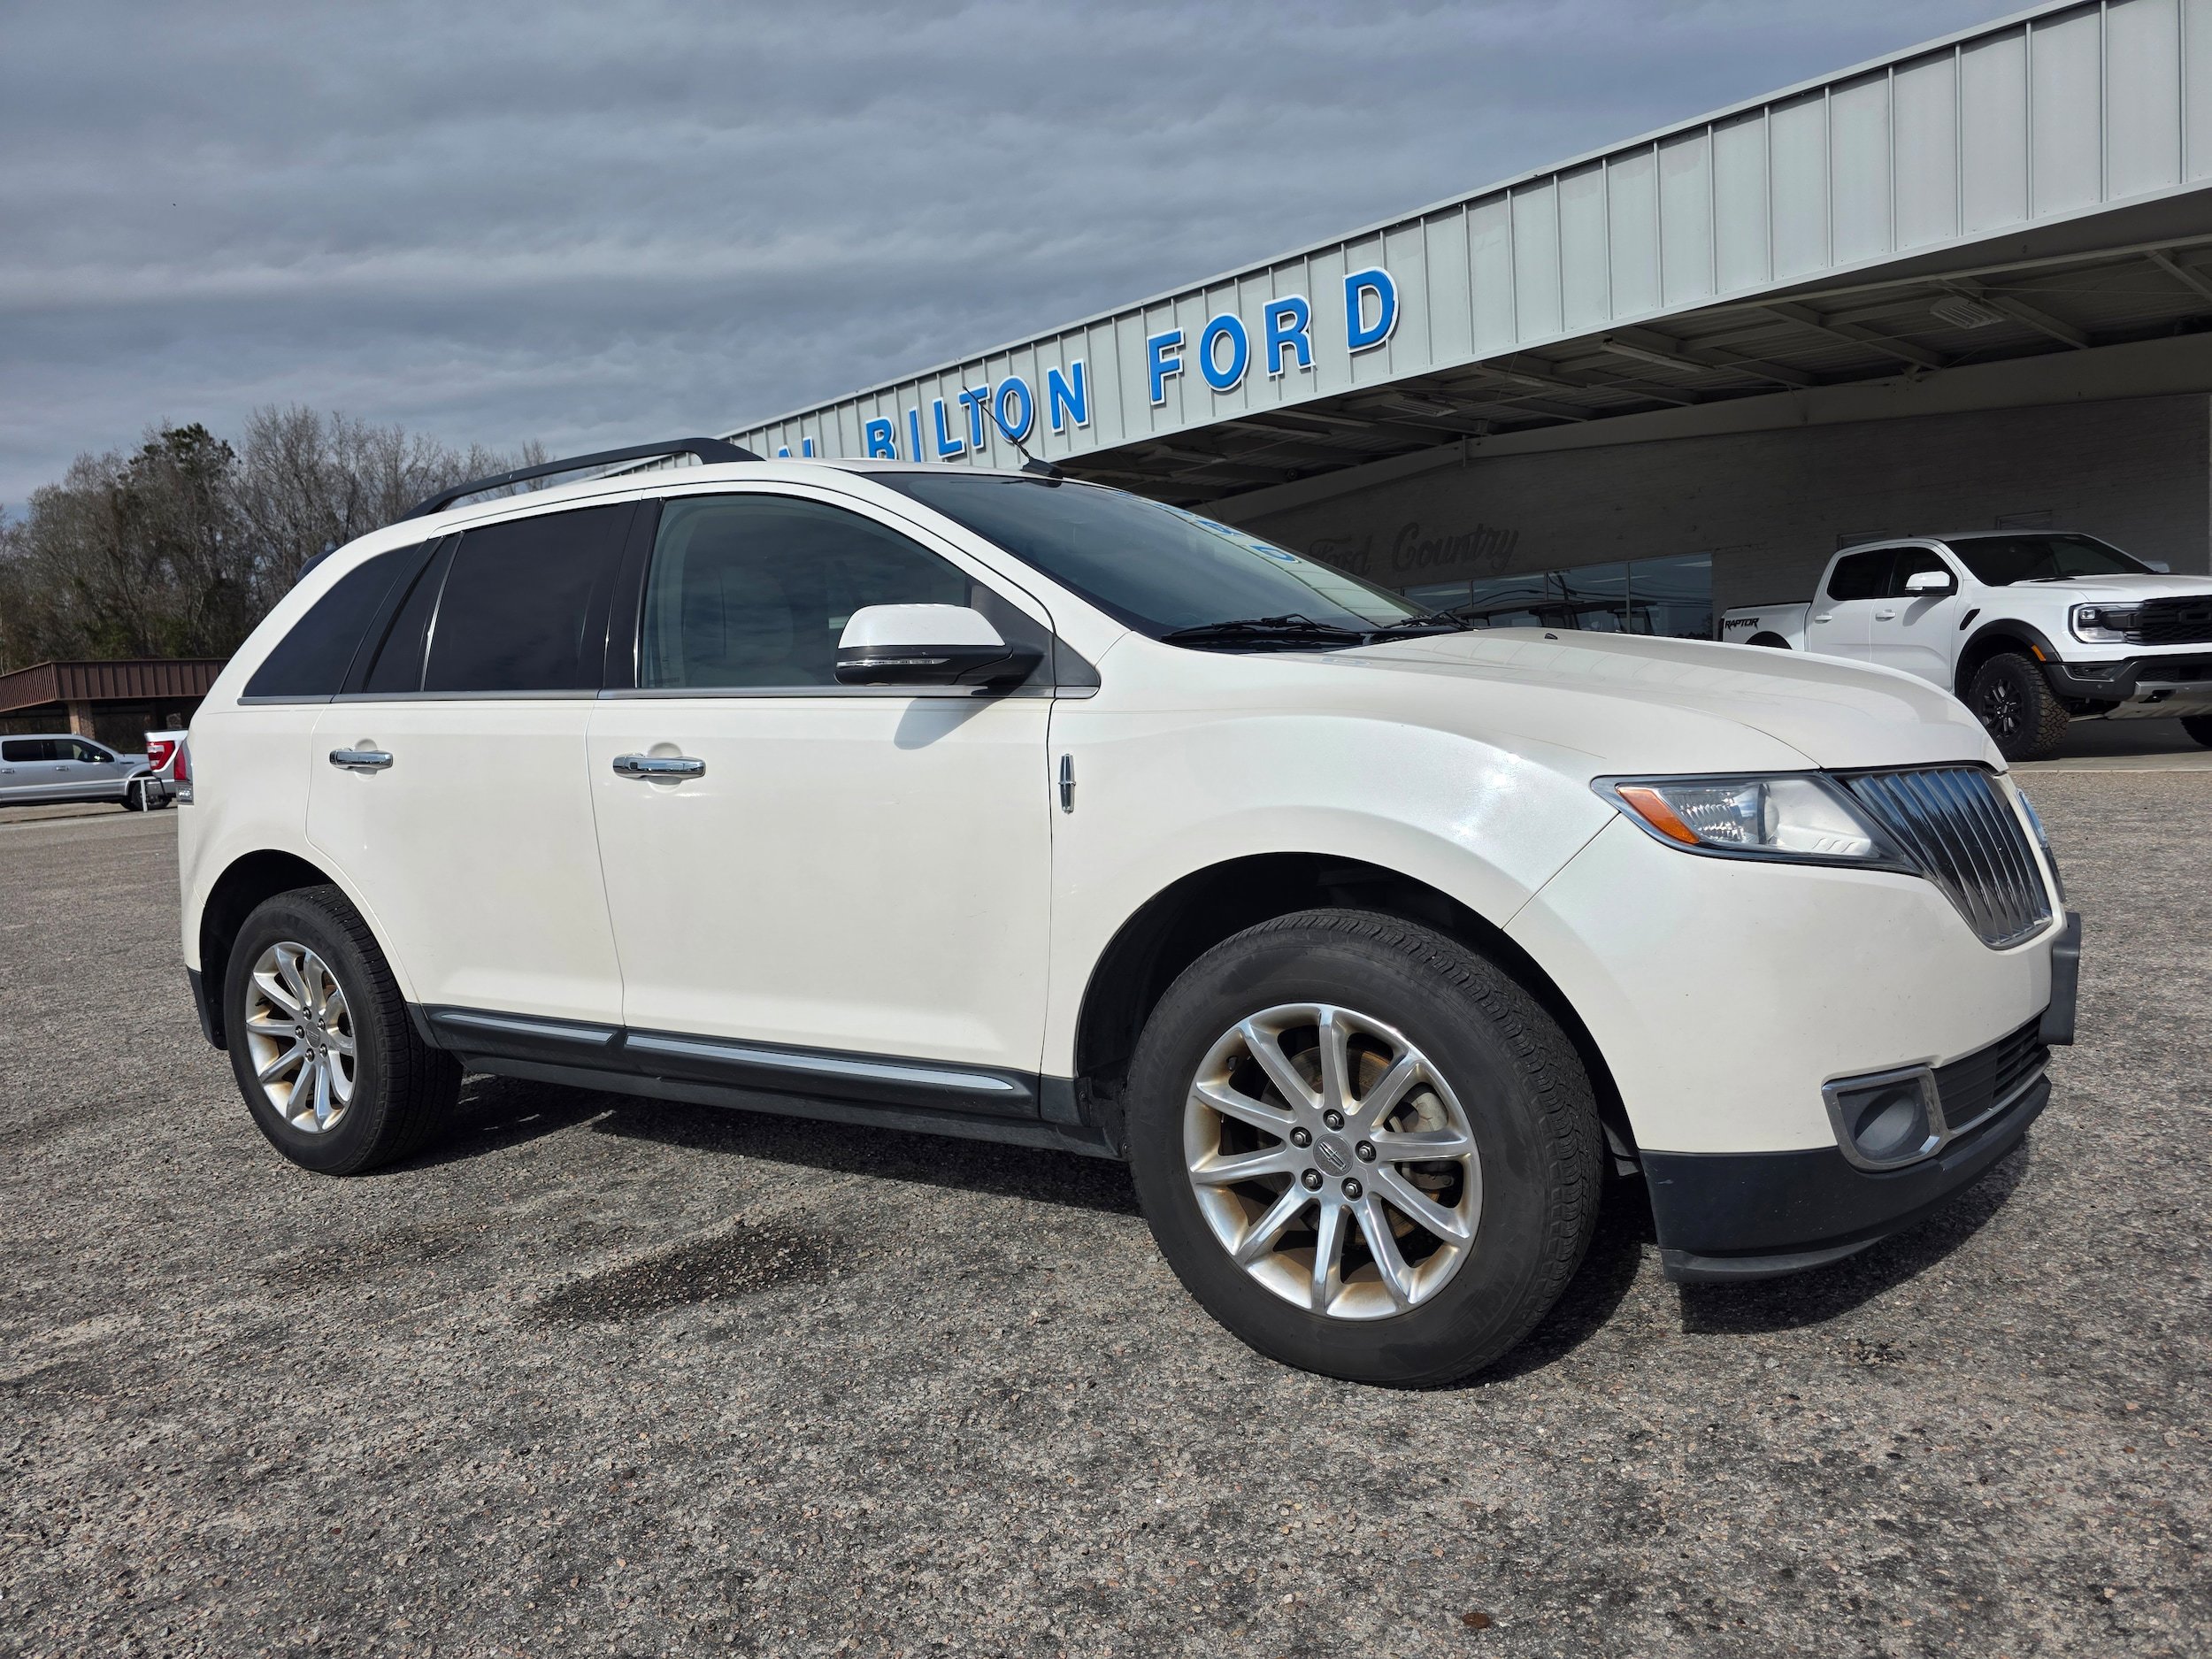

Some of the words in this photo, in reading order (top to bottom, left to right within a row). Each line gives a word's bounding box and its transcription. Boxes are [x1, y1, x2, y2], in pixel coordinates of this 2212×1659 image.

[864, 358, 1090, 462] BILTON
[1147, 266, 1400, 406] FORD
[1391, 522, 1519, 575] Country
[1724, 618, 1760, 631] RAPTOR
